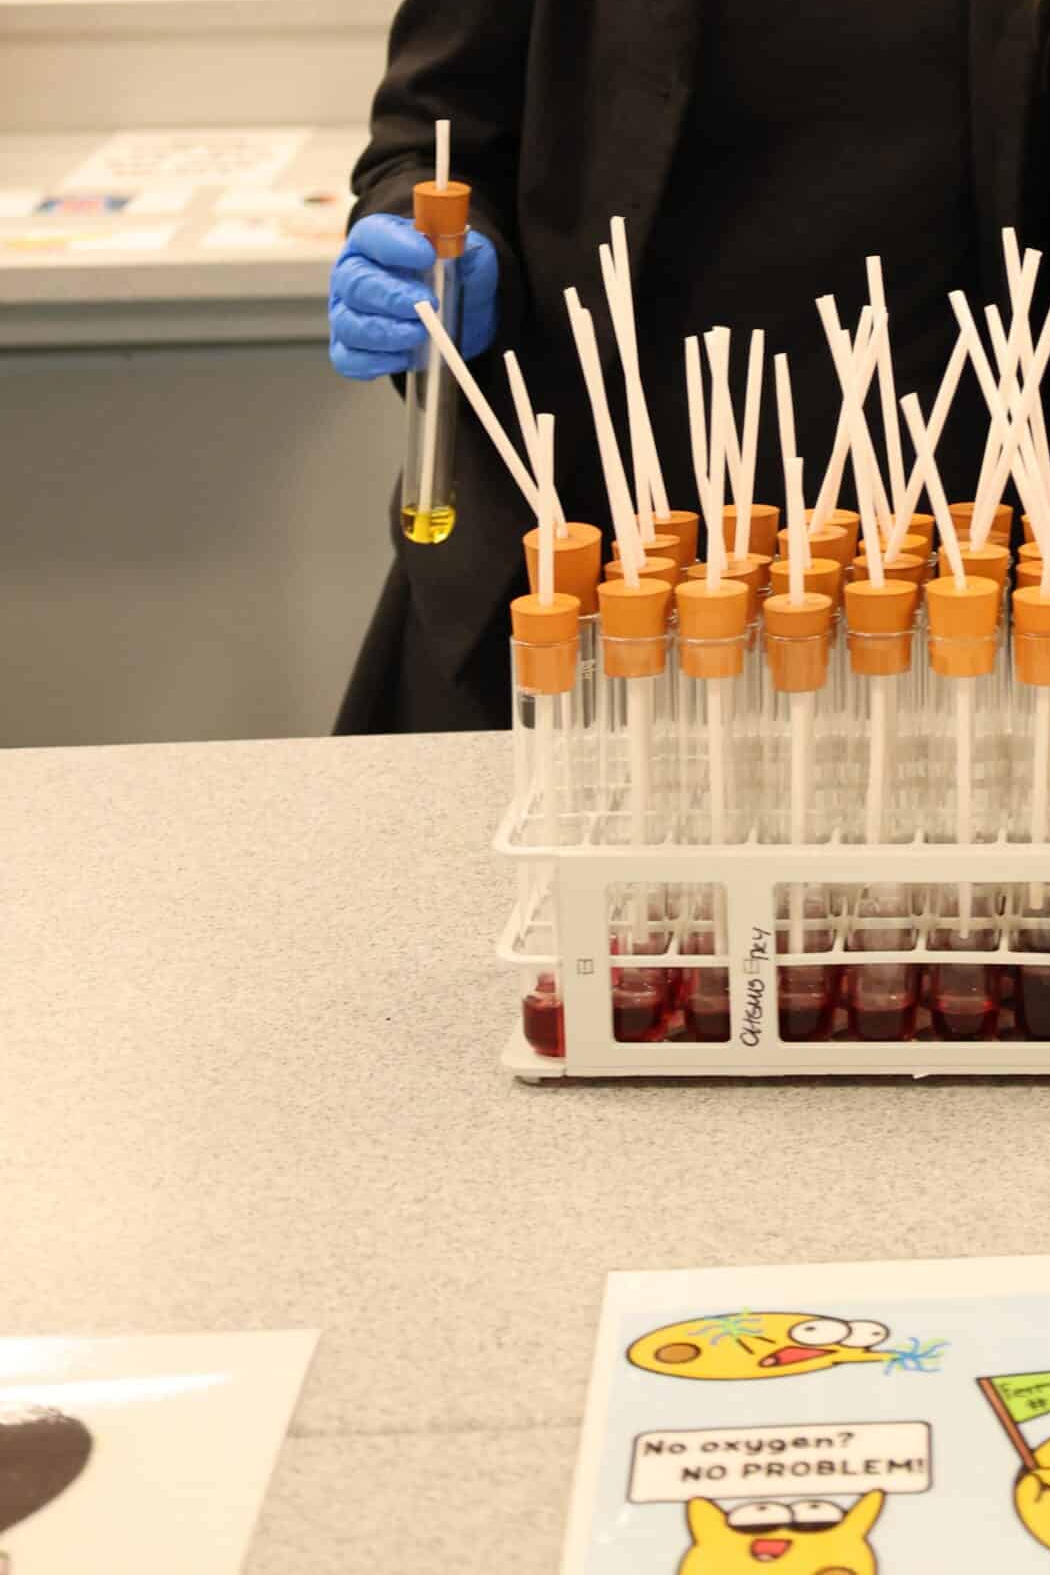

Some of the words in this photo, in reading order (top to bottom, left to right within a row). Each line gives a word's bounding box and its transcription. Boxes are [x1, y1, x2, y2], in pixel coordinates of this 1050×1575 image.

[643, 1439, 688, 1456] No
[700, 1431, 856, 1456] oxygen?
[680, 1464, 727, 1482] NO
[741, 1456, 926, 1480] PROBLEM!
